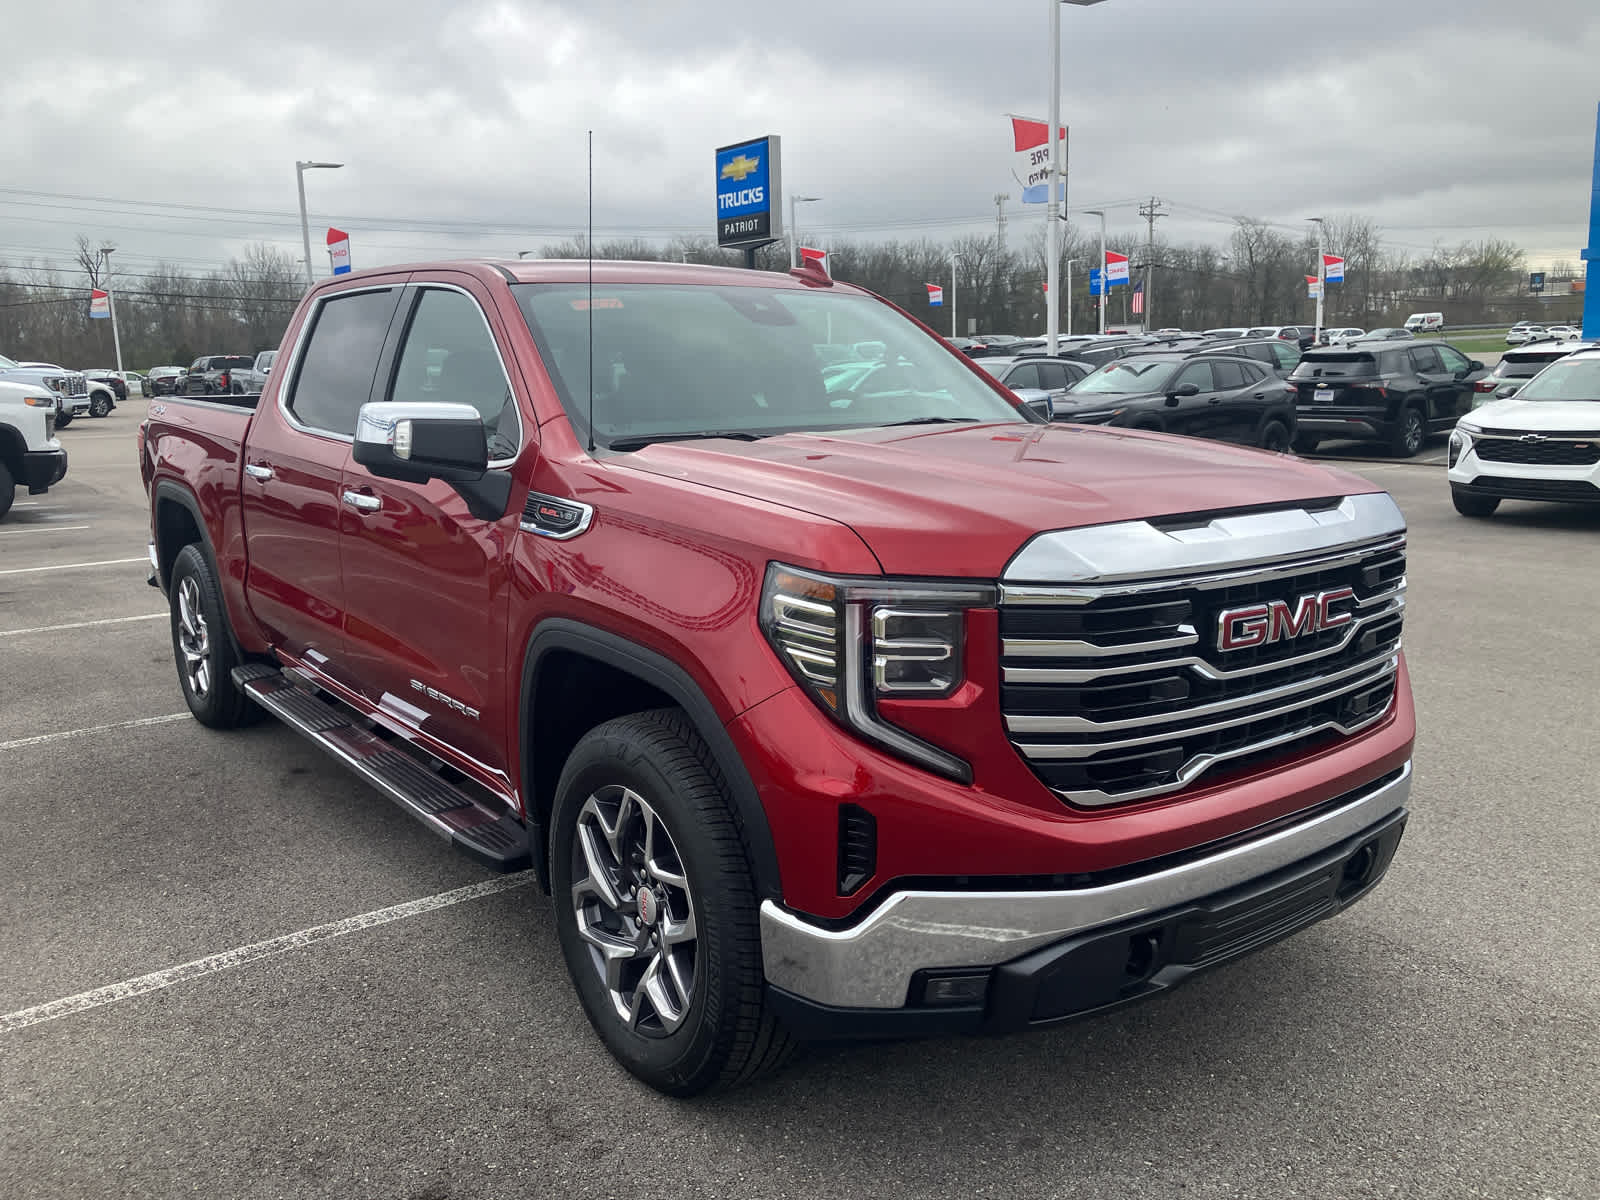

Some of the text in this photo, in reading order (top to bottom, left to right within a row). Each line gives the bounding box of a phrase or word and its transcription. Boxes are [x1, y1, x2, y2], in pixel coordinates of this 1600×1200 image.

[718, 186, 764, 209] TRUCKS
[725, 219, 759, 235] PATRIOT
[1217, 587, 1353, 652] GMC
[410, 679, 481, 721] SIERRA
